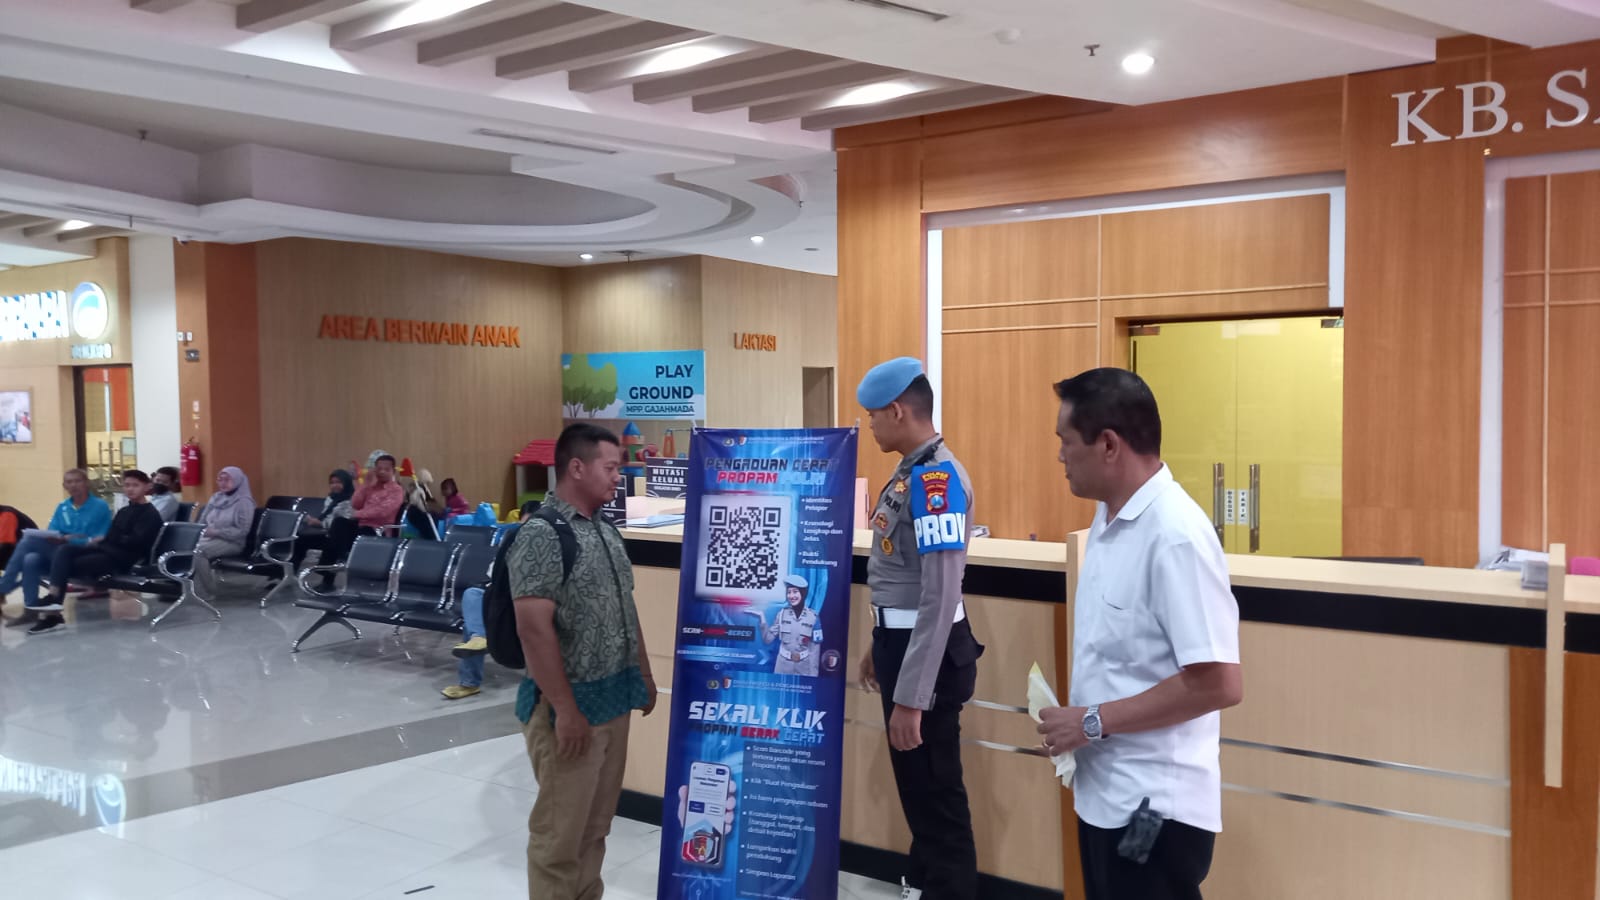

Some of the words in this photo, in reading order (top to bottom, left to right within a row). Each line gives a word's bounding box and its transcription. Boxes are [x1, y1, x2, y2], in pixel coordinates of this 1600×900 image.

[1391, 80, 1523, 147] KB.
[1546, 68, 1600, 129] S
[319, 314, 380, 341] AREA
[384, 318, 469, 346] BERMAIN
[472, 324, 520, 347] ANAK
[734, 332, 776, 351] LAKTASI
[655, 364, 694, 378] PLAY
[629, 386, 694, 400] GROUND
[626, 405, 642, 413] MPP
[645, 404, 694, 413] GAJAHMADA
[652, 468, 684, 476] MUTASI
[705, 458, 788, 472] PENGADUAN
[652, 476, 685, 484] KELUAR
[716, 471, 778, 484] PROPAM
[914, 512, 966, 549] PROV
[802, 559, 838, 567] Pendukung
[688, 701, 770, 726] SEKALI
[775, 707, 827, 731] KLIK
[688, 723, 737, 737] PROPAM
[783, 729, 825, 744] CEPAT
[769, 747, 793, 755] Barcode
[795, 750, 811, 758] yang
